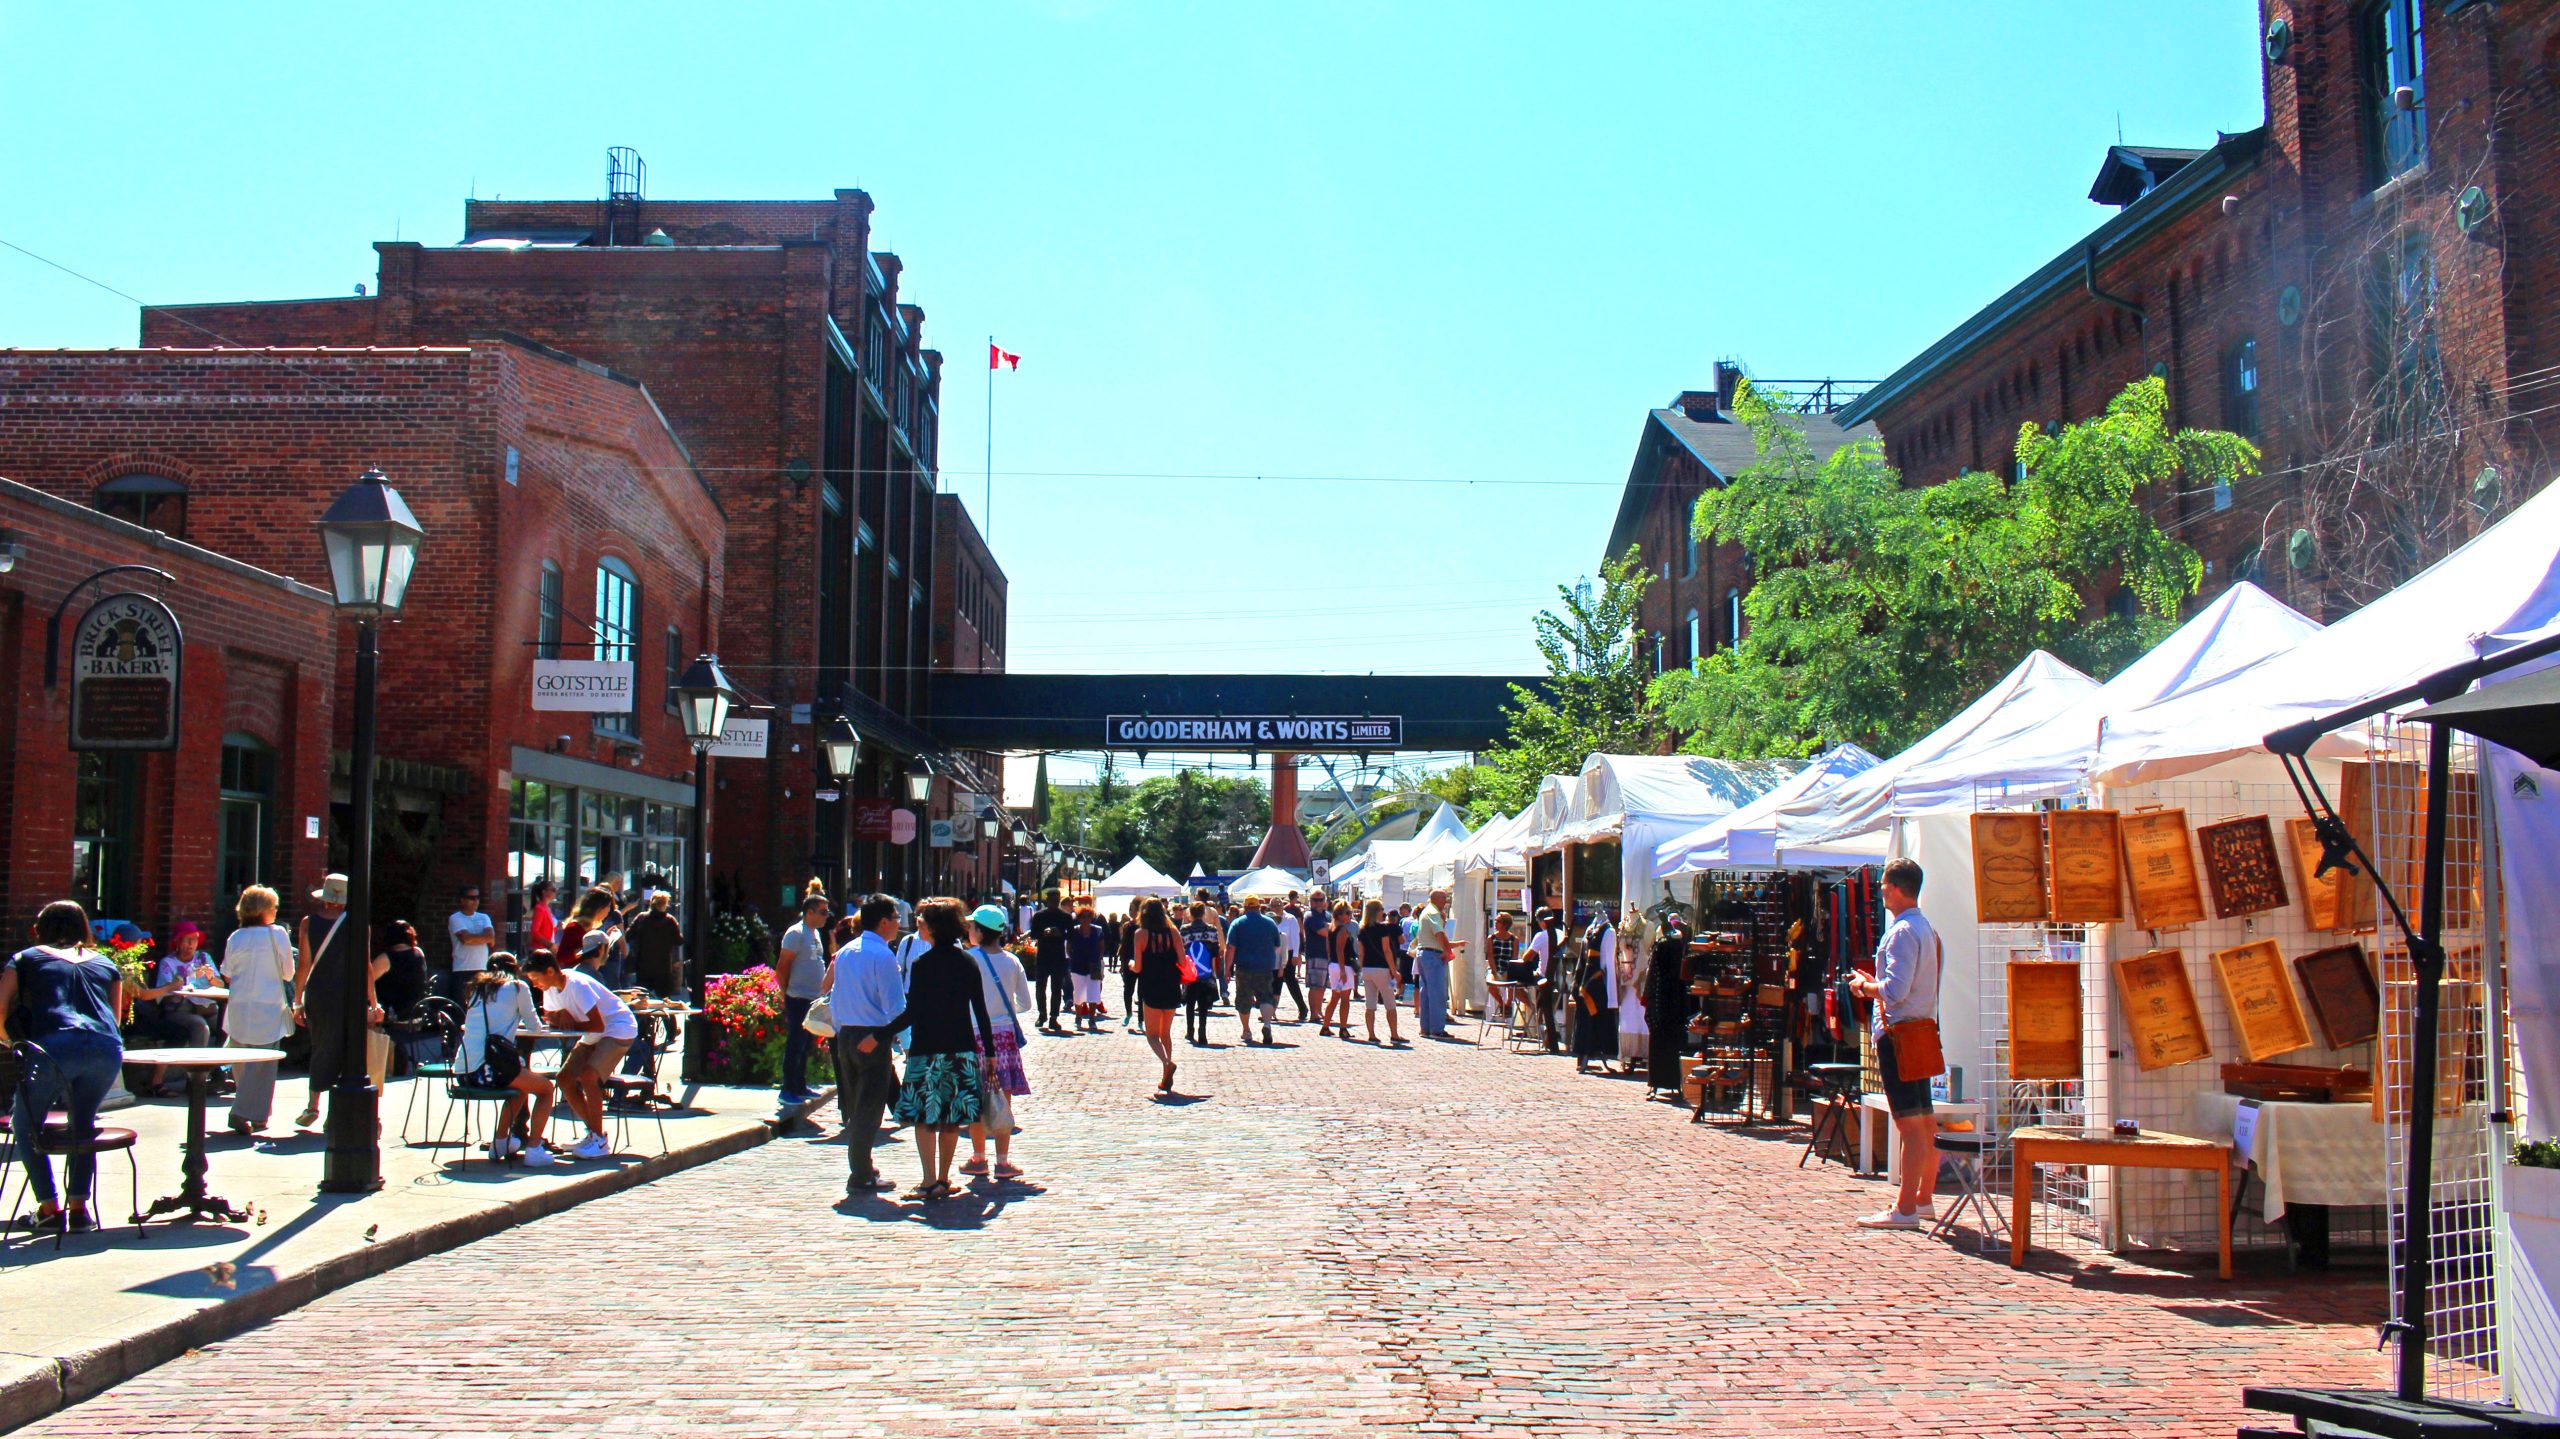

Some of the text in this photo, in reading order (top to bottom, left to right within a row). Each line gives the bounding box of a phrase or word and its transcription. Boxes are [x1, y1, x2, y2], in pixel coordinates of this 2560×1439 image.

[80, 604, 172, 656] BRICK STREET
[91, 660, 164, 674] BAKERY
[537, 675, 628, 691] GOTSTYLE
[723, 730, 763, 742] STYLE
[1120, 721, 1390, 740] GOODERHAM & WORTS LIMITED
[1577, 899, 1620, 908] TORNTO
